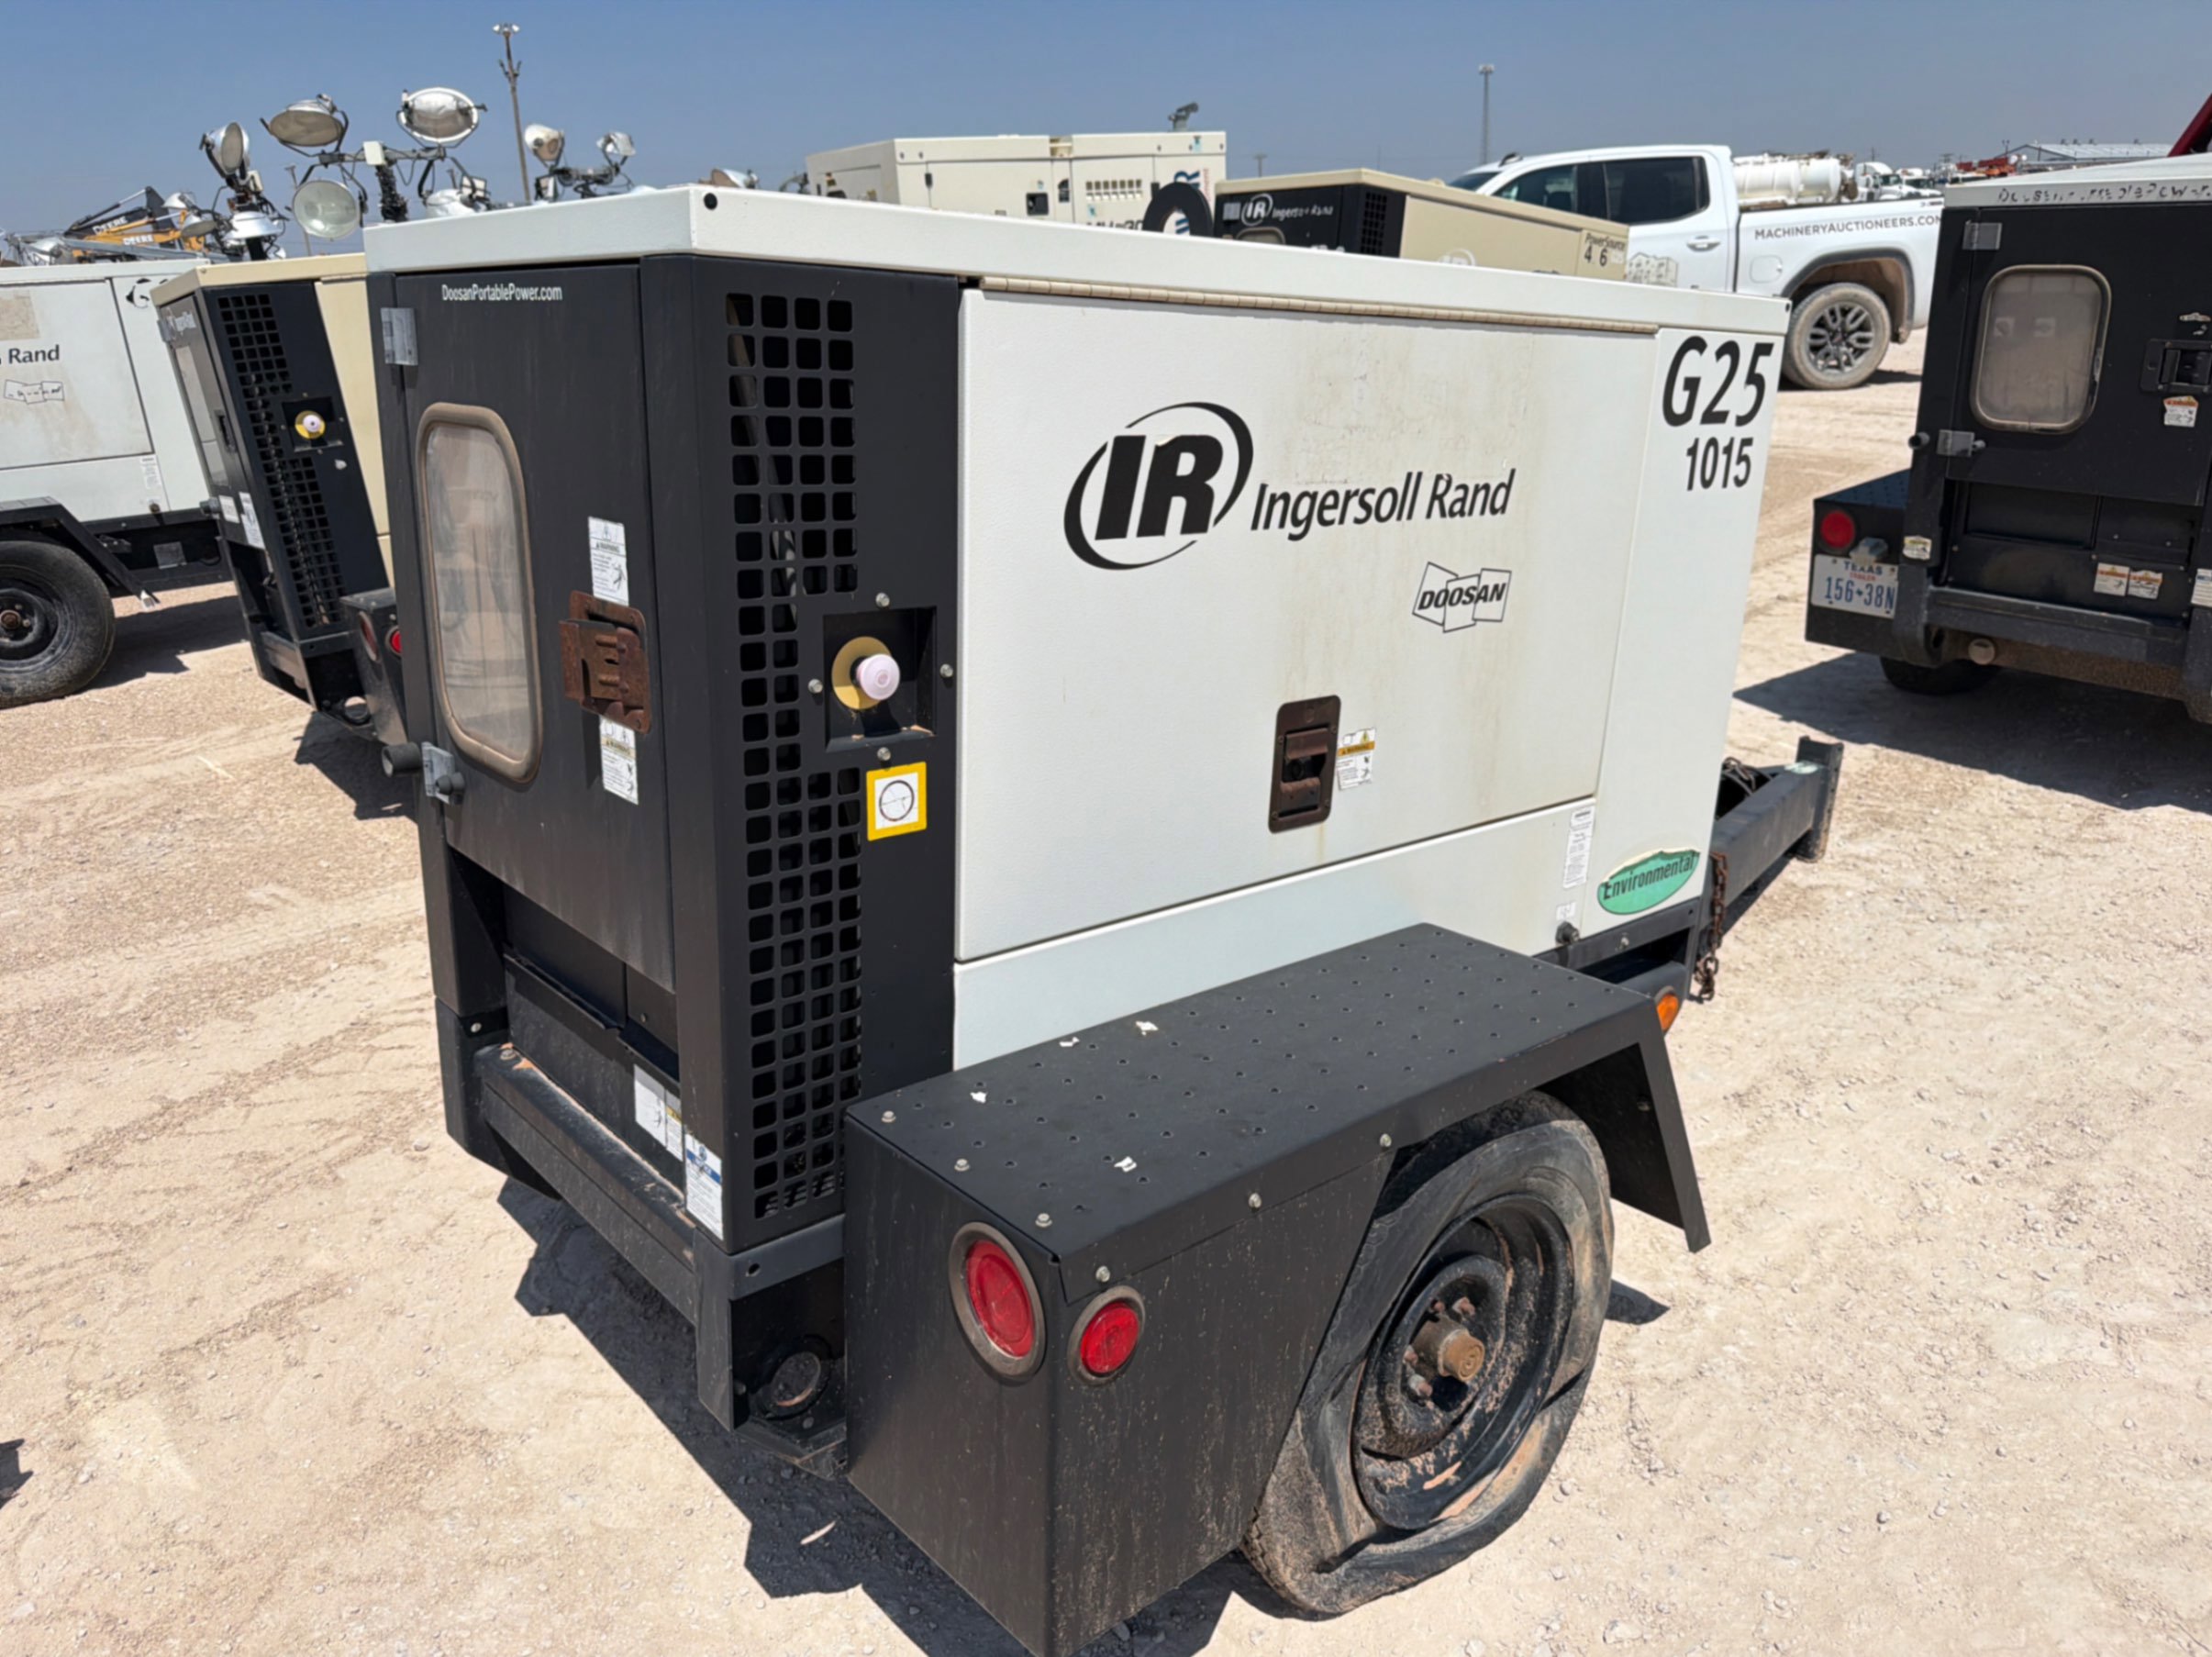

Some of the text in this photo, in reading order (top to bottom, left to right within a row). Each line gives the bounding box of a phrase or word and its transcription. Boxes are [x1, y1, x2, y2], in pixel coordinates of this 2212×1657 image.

[441, 283, 562, 301] DoosanPortablePower.com
[8, 344, 60, 364] Rand
[1662, 335, 1774, 428] G25
[1686, 437, 1754, 492] 1015
[1095, 434, 1517, 542] IR Ingersoll Rand
[1417, 583, 1507, 612] DOOSAN
[1603, 854, 1695, 900] Environmental
